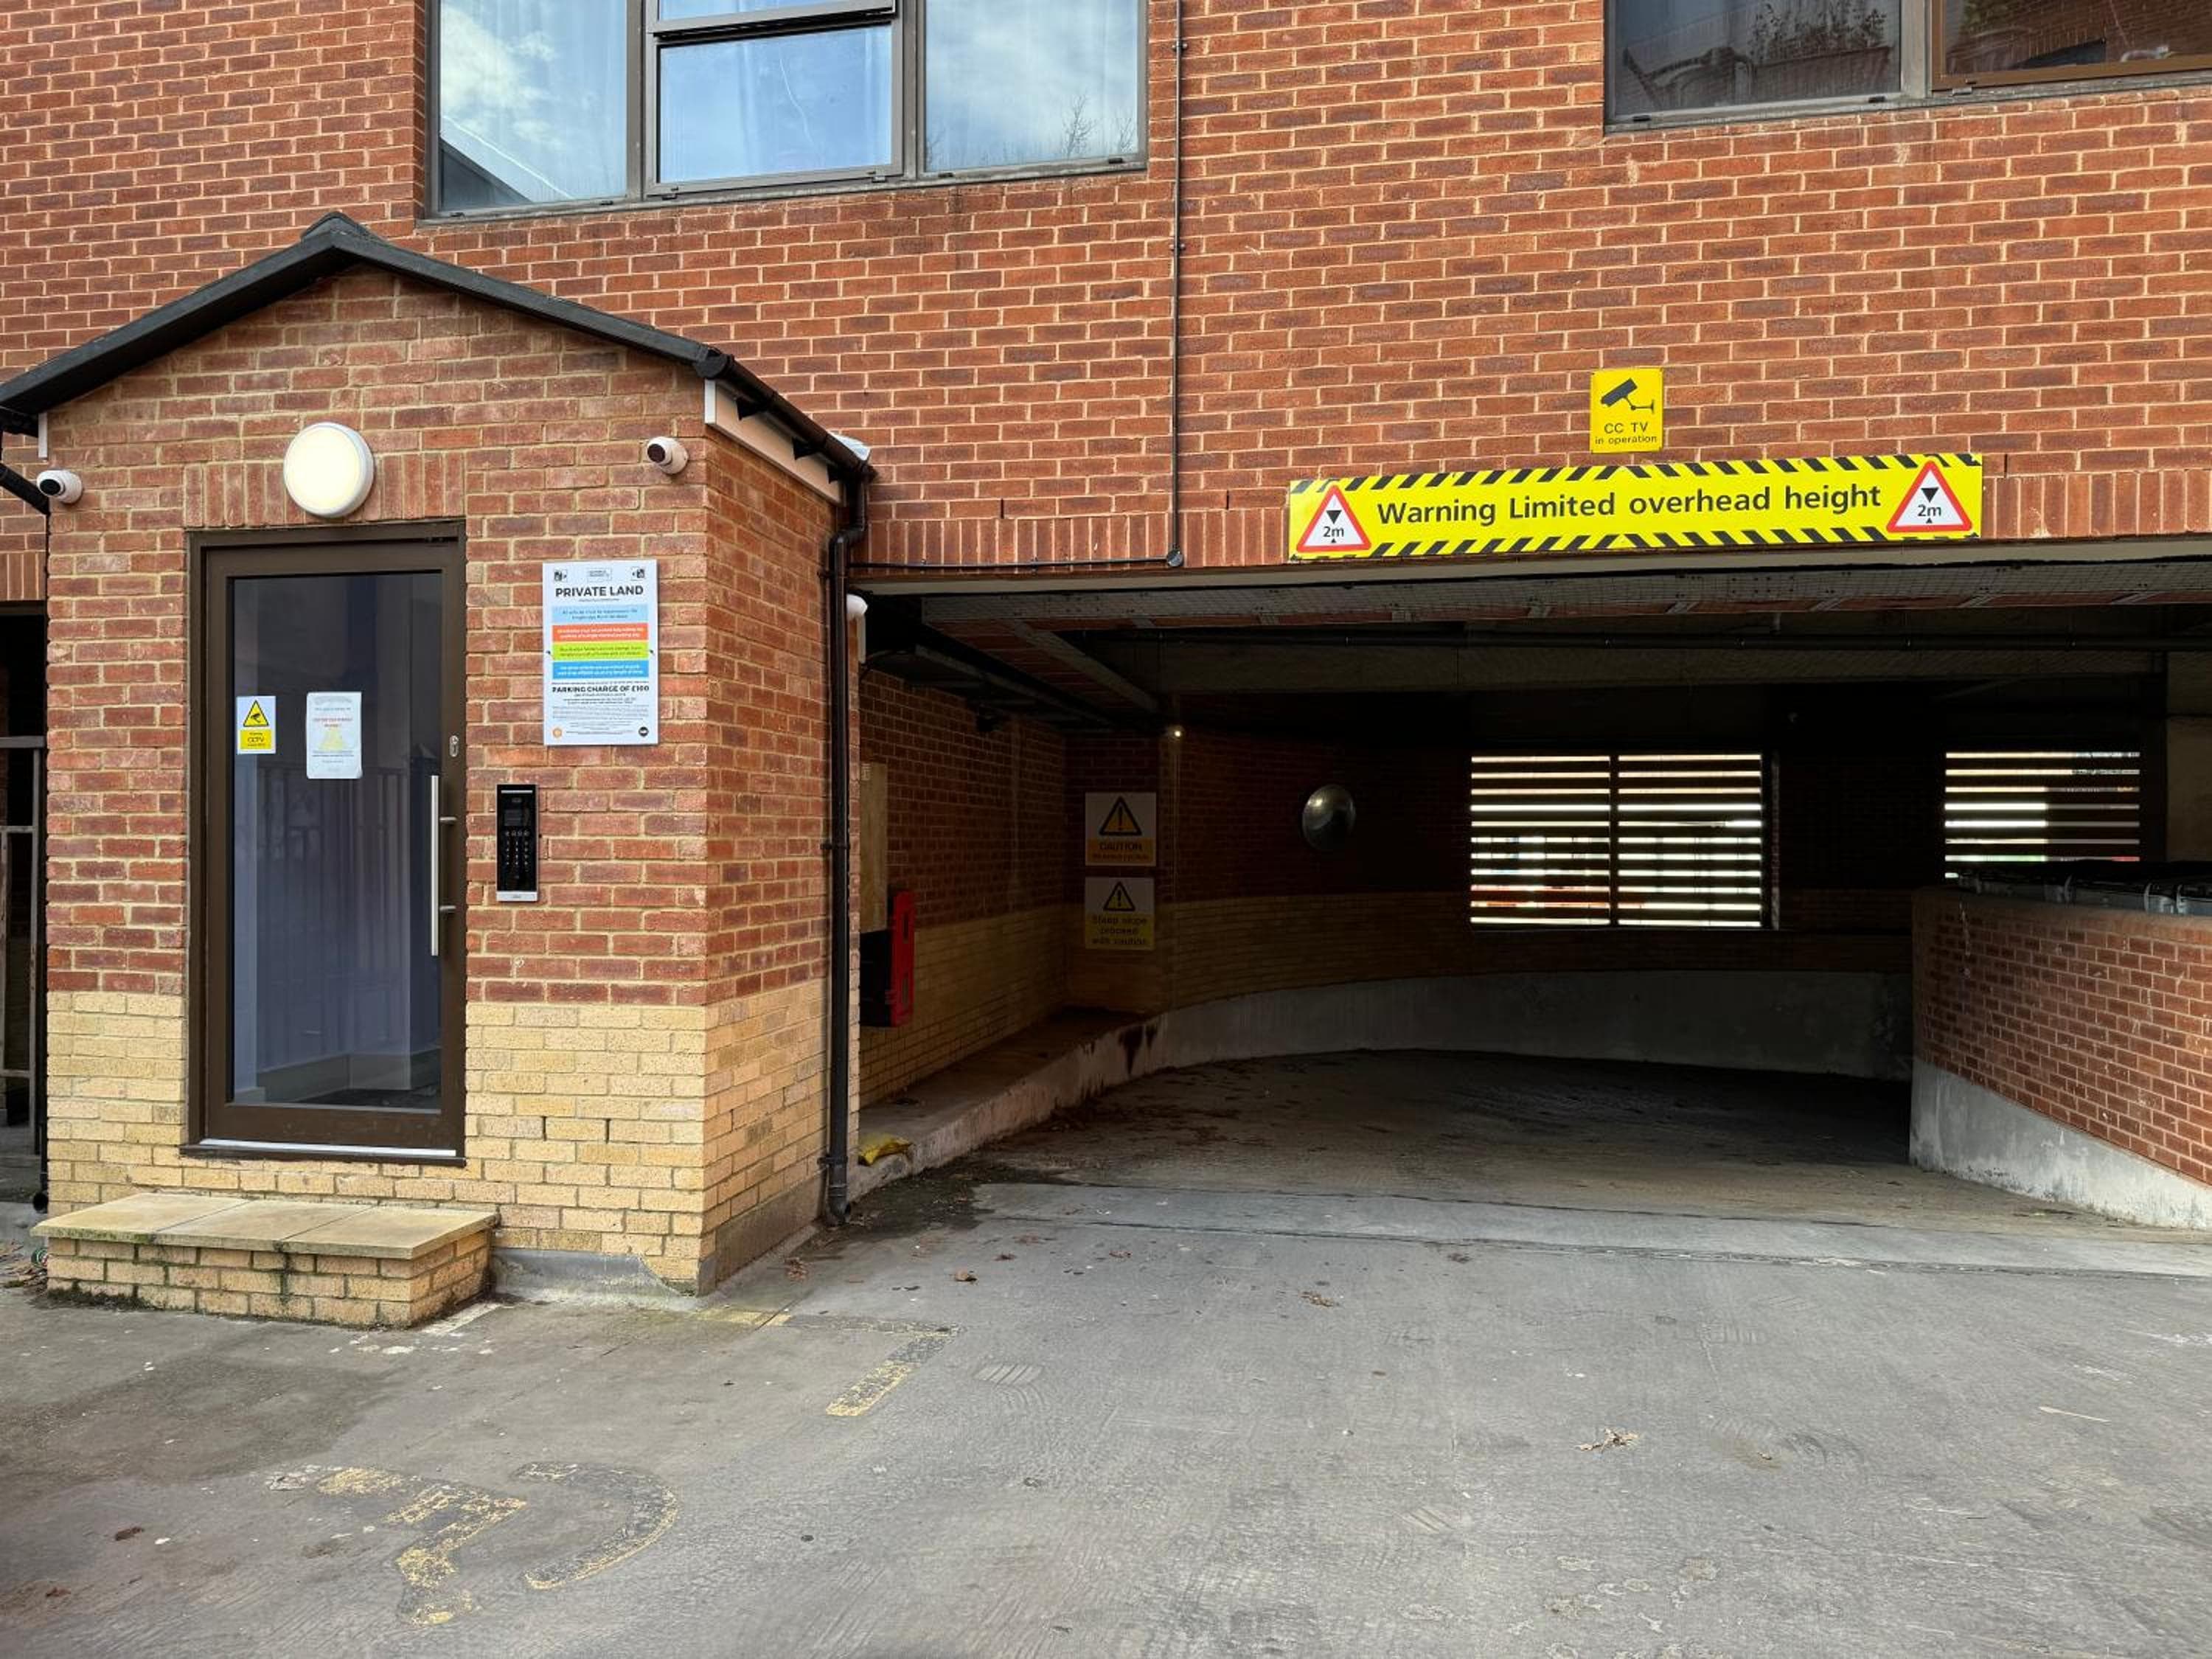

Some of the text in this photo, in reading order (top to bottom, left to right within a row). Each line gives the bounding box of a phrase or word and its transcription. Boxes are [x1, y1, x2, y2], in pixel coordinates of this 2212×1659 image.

[1604, 421, 1648, 434] CC TV
[1595, 435, 1657, 445] in operation
[1377, 484, 1881, 526] Warning Limited overhead height
[1917, 504, 1942, 518] 2m
[1323, 525, 1345, 538] 2m
[555, 585, 644, 597] PRIVATE LAND
[1098, 841, 1143, 850] CAUTION
